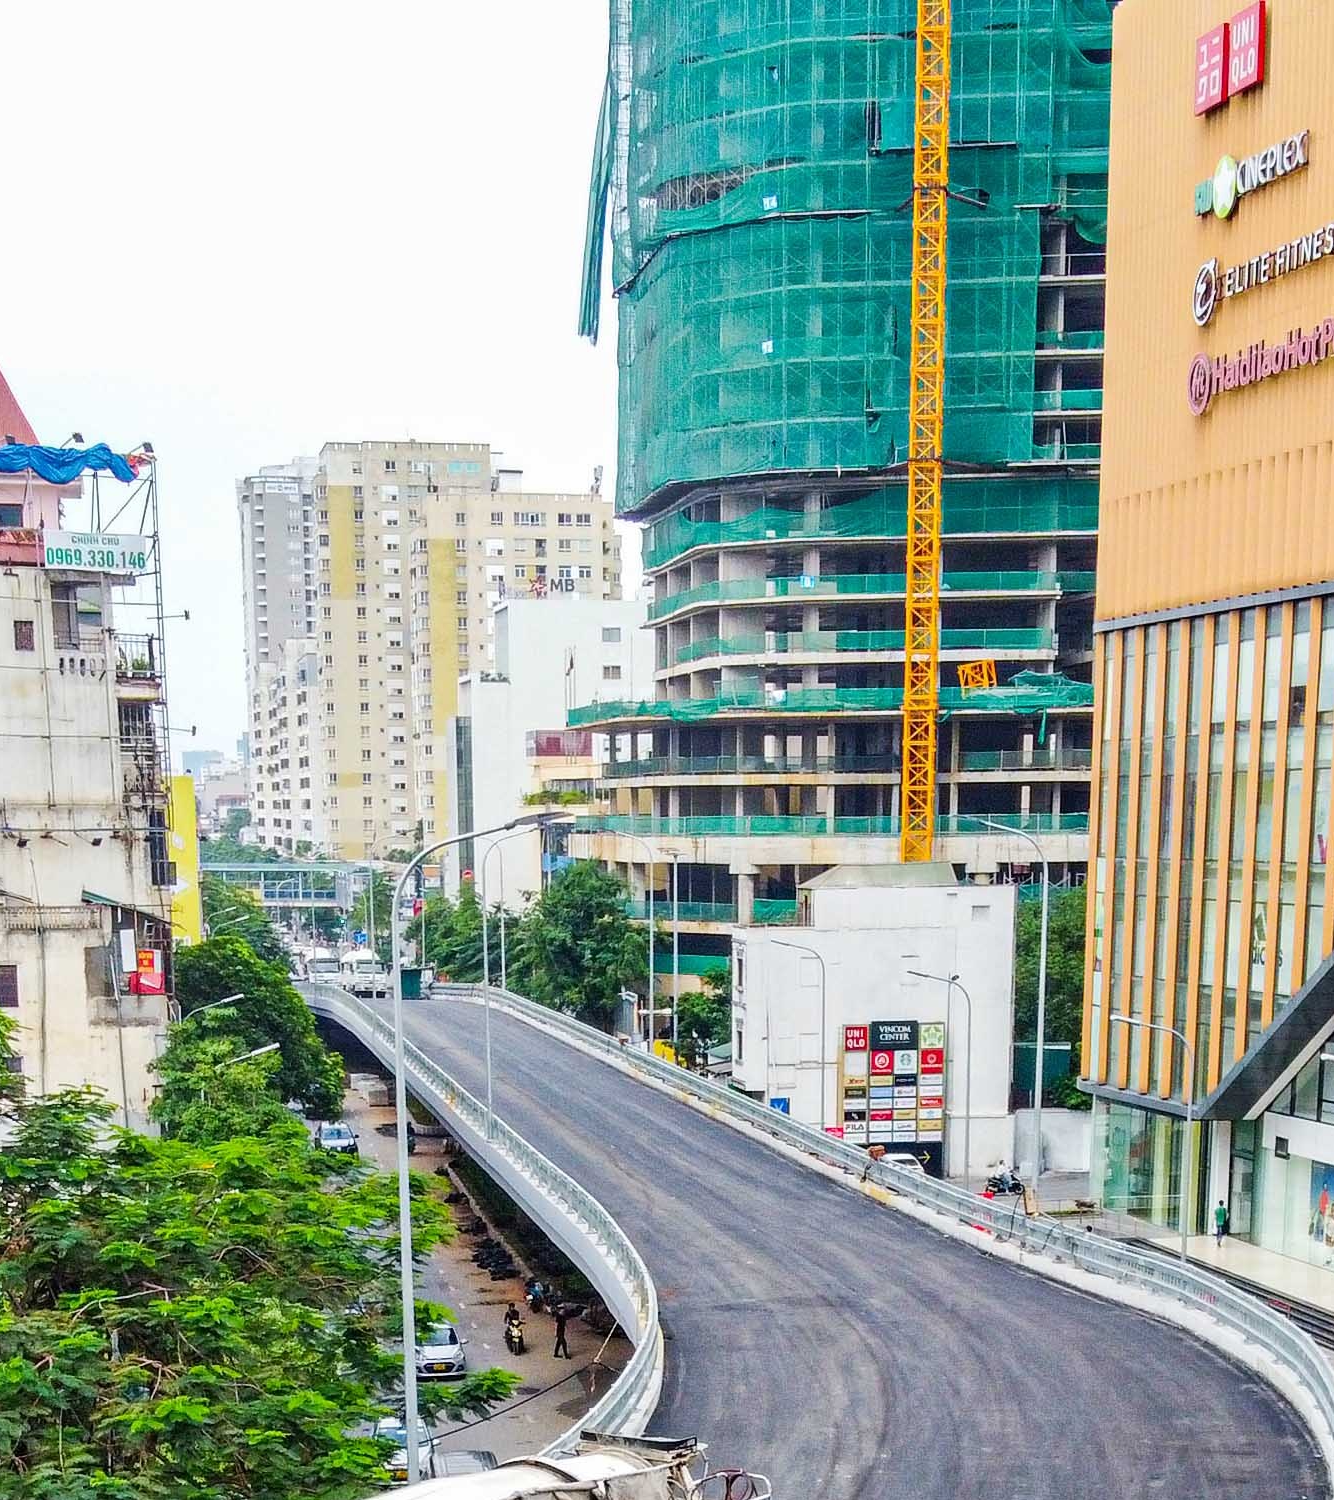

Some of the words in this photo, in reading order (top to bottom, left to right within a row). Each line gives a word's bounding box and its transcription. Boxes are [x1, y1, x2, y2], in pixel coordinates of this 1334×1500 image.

[1232, 15, 1255, 49] UNI
[1231, 48, 1255, 87] QLO
[1237, 131, 1308, 196] CINEPLEX
[1225, 252, 1271, 297] ELITE
[46, 547, 146, 569] 0969.330.146
[550, 578, 575, 592] MB
[847, 1029, 864, 1038] UNI
[878, 1025, 912, 1033] VINCOM
[879, 1033, 910, 1041] CENTER
[847, 1039, 865, 1048] QLO
